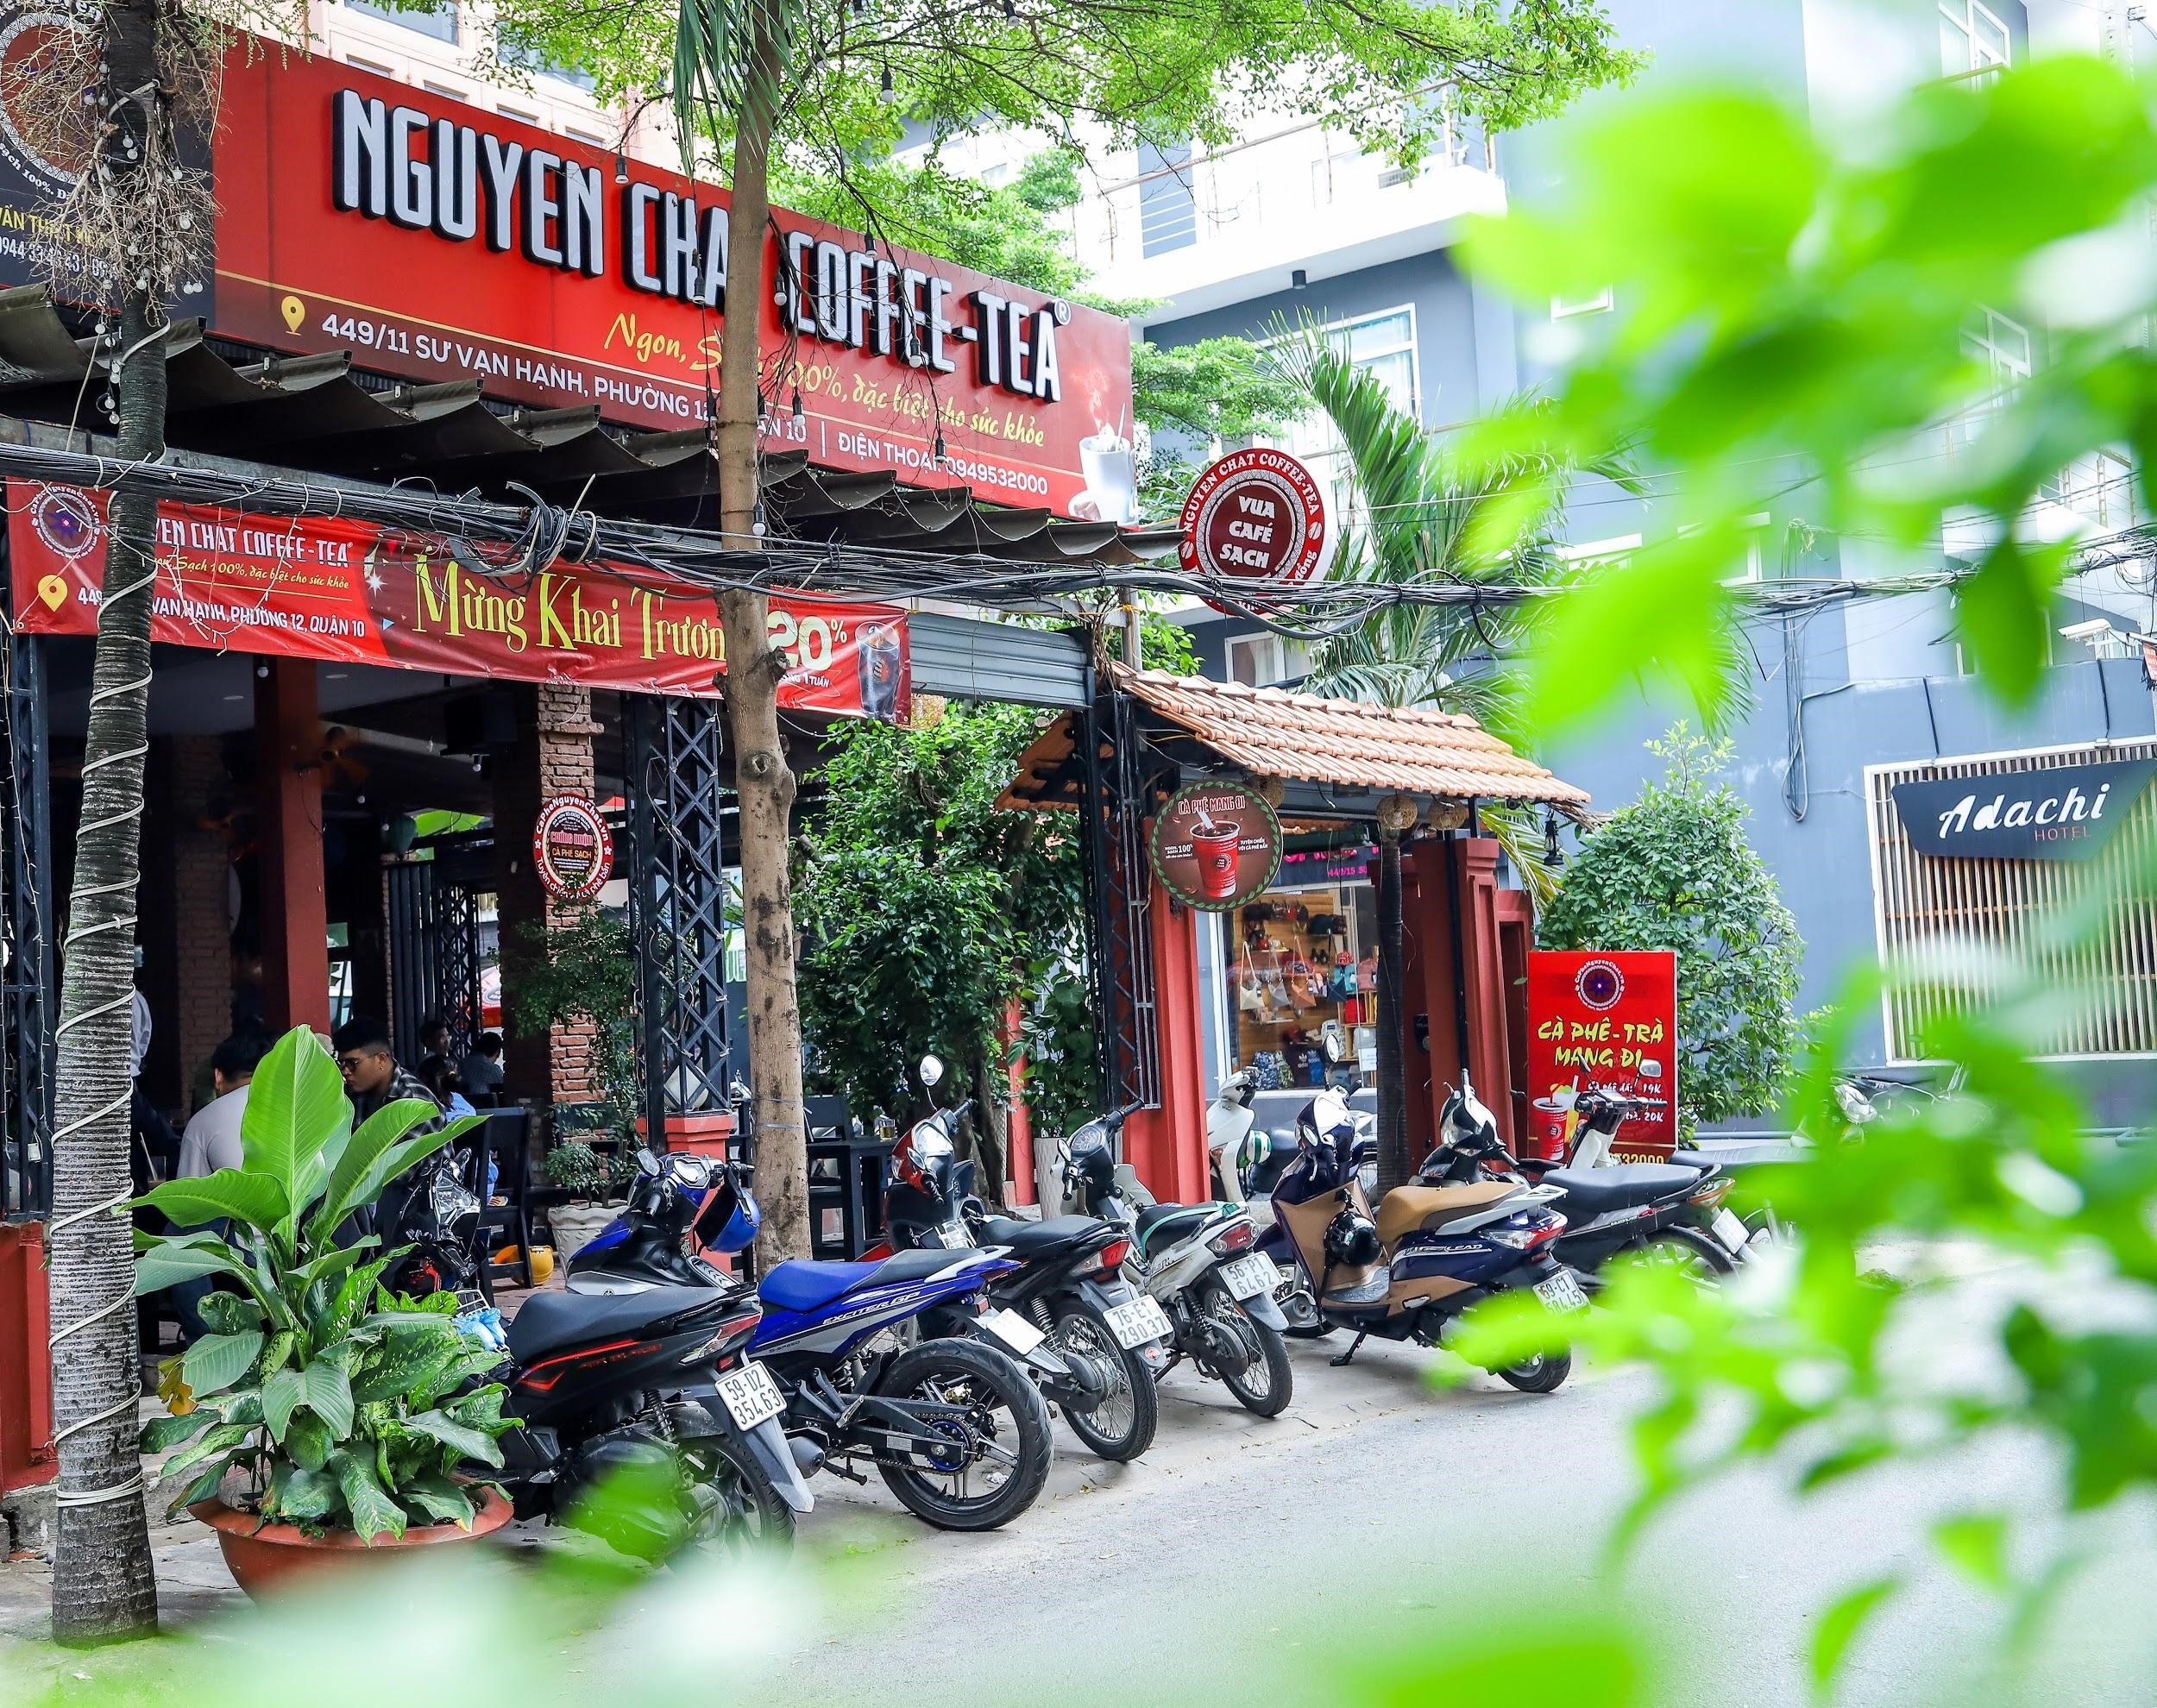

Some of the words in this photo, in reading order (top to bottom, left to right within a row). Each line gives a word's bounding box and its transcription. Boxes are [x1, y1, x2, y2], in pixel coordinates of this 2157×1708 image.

[335, 89, 604, 276] NGUYEN
[624, 181, 730, 309] CHA
[603, 312, 687, 363] Ngon,
[852, 373, 888, 414] đặc
[934, 396, 965, 428] cho
[970, 406, 999, 436] sức
[1003, 411, 1045, 447] khỏe
[321, 313, 411, 356] 449/11
[415, 333, 452, 363] SƯ
[455, 343, 509, 378] VẠN
[515, 356, 589, 398] HẠNH,
[594, 375, 690, 418] PHƯỜNG
[838, 432, 881, 460] ĐIỆN
[944, 456, 1048, 495] 0949532000
[1182, 473, 1217, 533] NGUYEN
[1218, 452, 1255, 476] CHAT
[1237, 495, 1276, 520] VUA
[191, 523, 237, 553] CHAT
[1228, 521, 1273, 544] CAFÉ
[1219, 543, 1271, 569] SẠCH
[249, 565, 267, 581] đặc
[290, 571, 307, 585] cho
[308, 574, 325, 587] sức
[326, 575, 350, 590] khỏe
[230, 604, 288, 629] PHƯỜNG
[289, 613, 309, 633] 12,
[309, 614, 349, 637] QUẬN
[351, 619, 366, 638] 10
[412, 553, 528, 654] Mừng
[535, 572, 623, 651] Khai
[630, 586, 726, 662] Trươn
[536, 795, 609, 842] CaPheNguyenChat.vn
[1178, 798, 1192, 815] CÀ
[1210, 795, 1235, 812] MANG
[1938, 782, 2111, 840] Adachi
[2034, 826, 2091, 842] HOTEL
[551, 846, 561, 857] CÀ
[574, 850, 592, 859] SẠCH
[1538, 1015, 1563, 1042] CÀ
[1643, 1083, 1662, 1094] 19K
[1644, 1111, 1664, 1122] 20K
[1236, 1272, 1275, 1299] 6462
[822, 1299, 890, 1326] EXCITER
[1118, 1316, 1167, 1347] 290.37
[733, 1388, 781, 1425] 354.63
